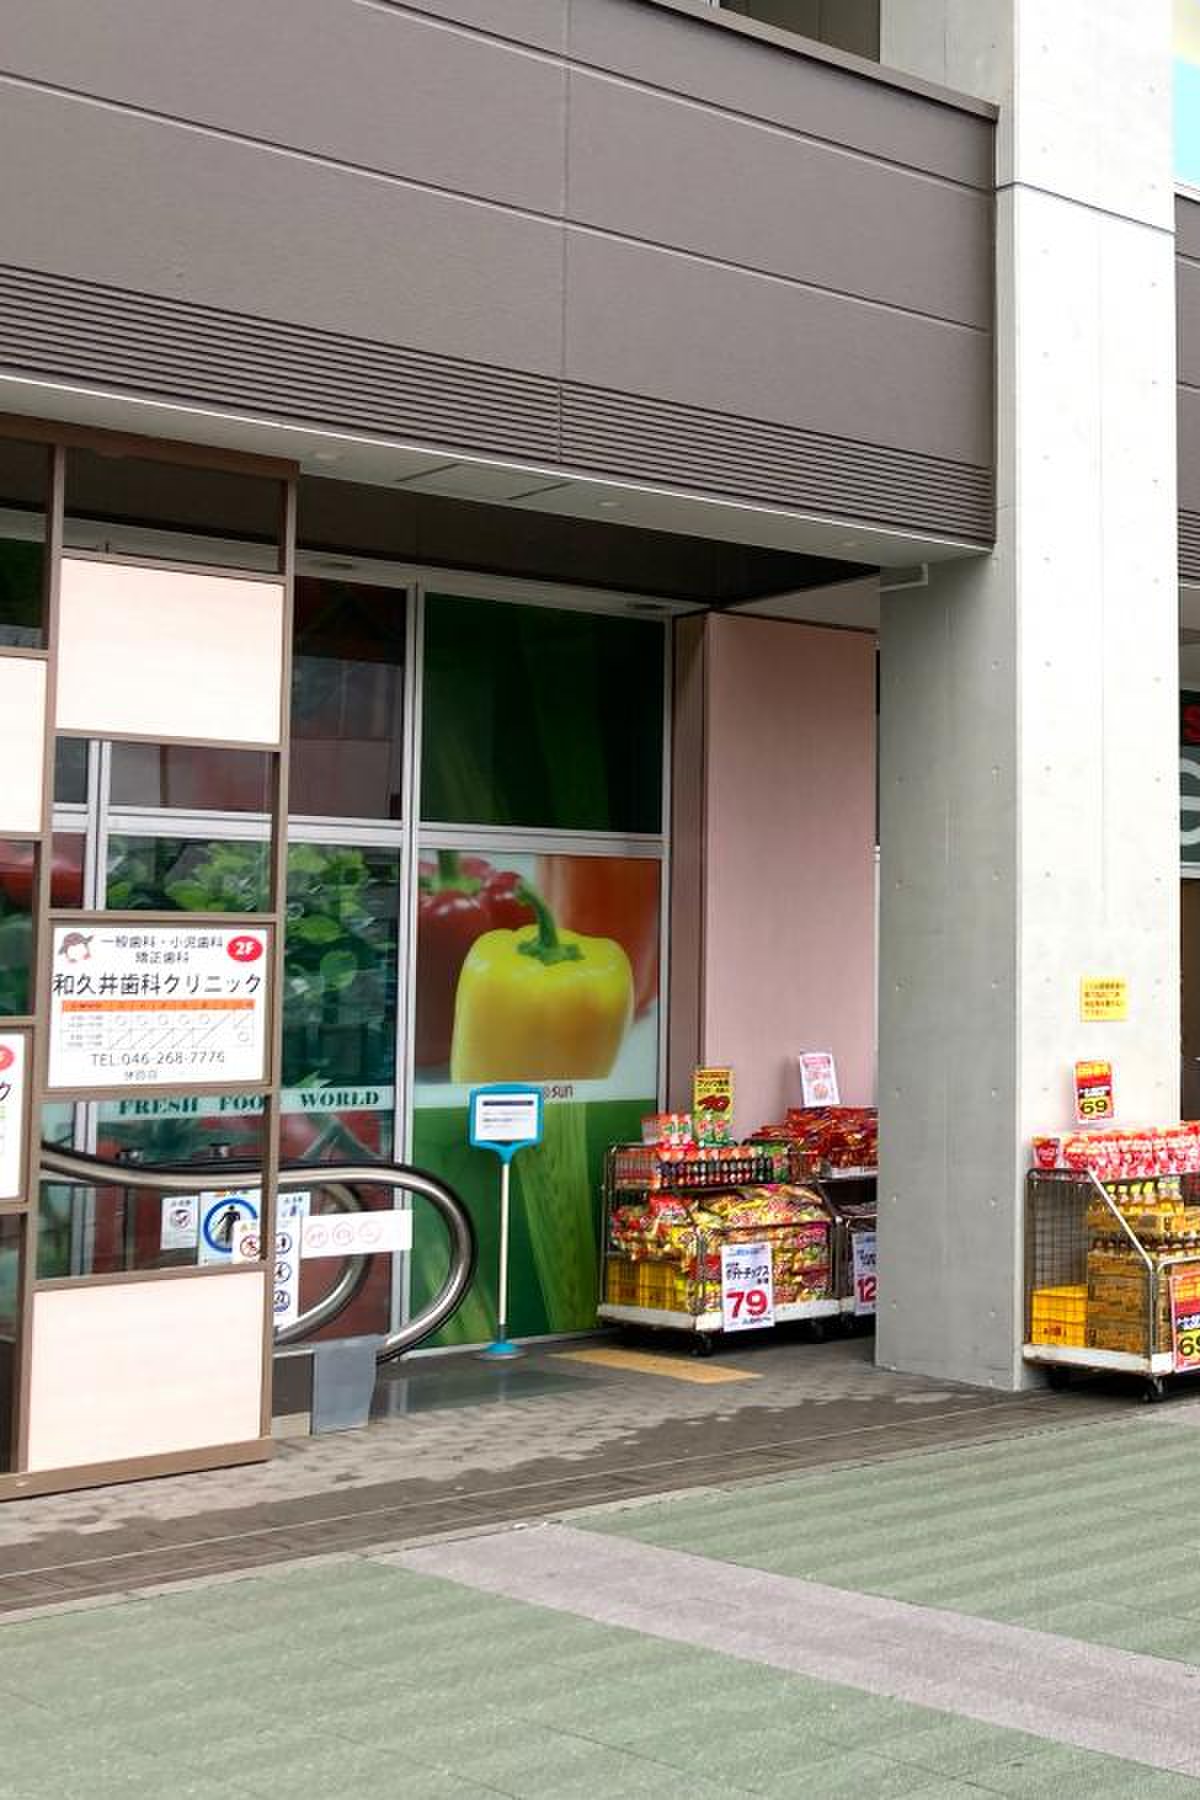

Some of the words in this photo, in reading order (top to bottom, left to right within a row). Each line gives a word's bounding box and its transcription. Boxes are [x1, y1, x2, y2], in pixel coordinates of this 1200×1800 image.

[235, 941, 254, 956] 2F
[53, 973, 261, 995] 和久井歯科クリニック
[119, 1097, 198, 1115] FRESH
[219, 1094, 268, 1111] FOO
[301, 1090, 379, 1107] WORLD
[1081, 1100, 1108, 1115] 69
[726, 1289, 768, 1318] 79
